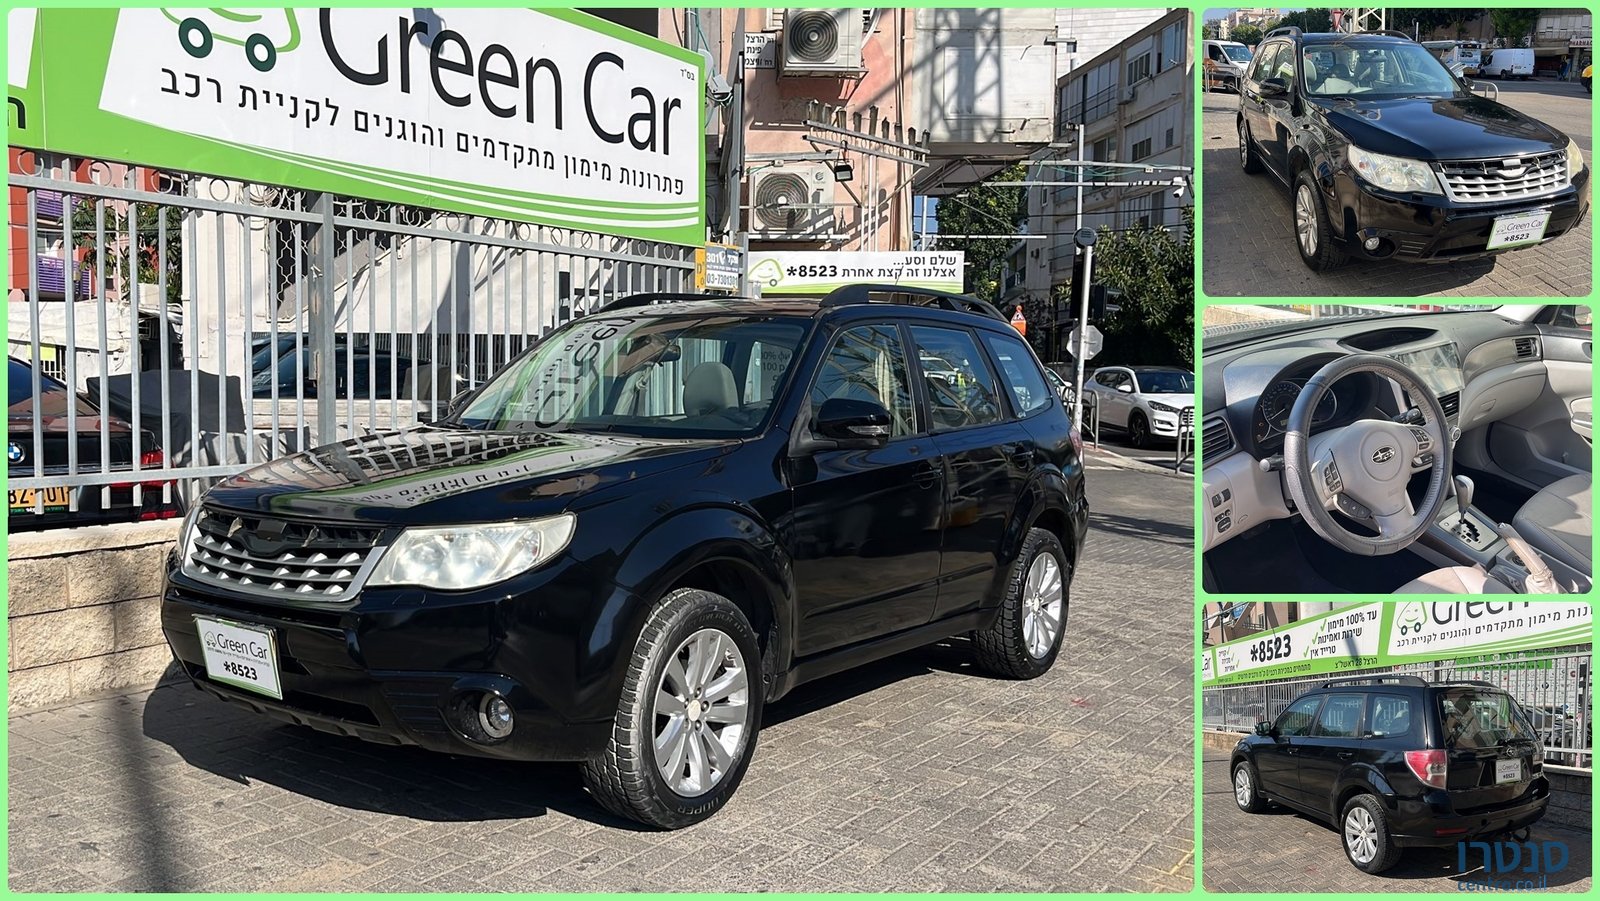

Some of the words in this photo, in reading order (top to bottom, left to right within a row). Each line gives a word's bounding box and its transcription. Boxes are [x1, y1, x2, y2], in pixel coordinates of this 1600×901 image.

[160, 67, 222, 104] רכב
[238, 84, 340, 129] לקניית
[583, 51, 682, 156] Car
[354, 109, 444, 149] והוגנים
[456, 131, 555, 169] מתקדמים
[563, 154, 612, 179] מימון
[618, 166, 684, 196] פתרונות
[1507, 222, 1530, 231] Green
[1530, 219, 1545, 228] Car
[893, 256, 926, 266] וסע...
[930, 255, 957, 266] שלם
[841, 266, 874, 278] אחרת
[877, 267, 902, 280] קצת
[906, 267, 919, 277] זה
[923, 267, 956, 278] אצלנו
[1346, 612, 1366, 626] 100%
[1366, 610, 1378, 621] עד
[1528, 610, 1561, 628] מימון
[1327, 618, 1345, 632] מימון
[1475, 618, 1524, 635] מתקדמים
[1317, 632, 1341, 645] ואמינות
[1341, 627, 1363, 640] שירות
[1411, 632, 1437, 646] לקניית
[1440, 627, 1471, 641] והוגנים
[217, 633, 249, 655] Green
[249, 641, 268, 660] Car
[1397, 638, 1410, 648] רכב
[1310, 648, 1319, 660] אין
[1319, 645, 1336, 656] טרייד
[1355, 658, 1363, 667] 28
[1363, 657, 1378, 666] הרצל
